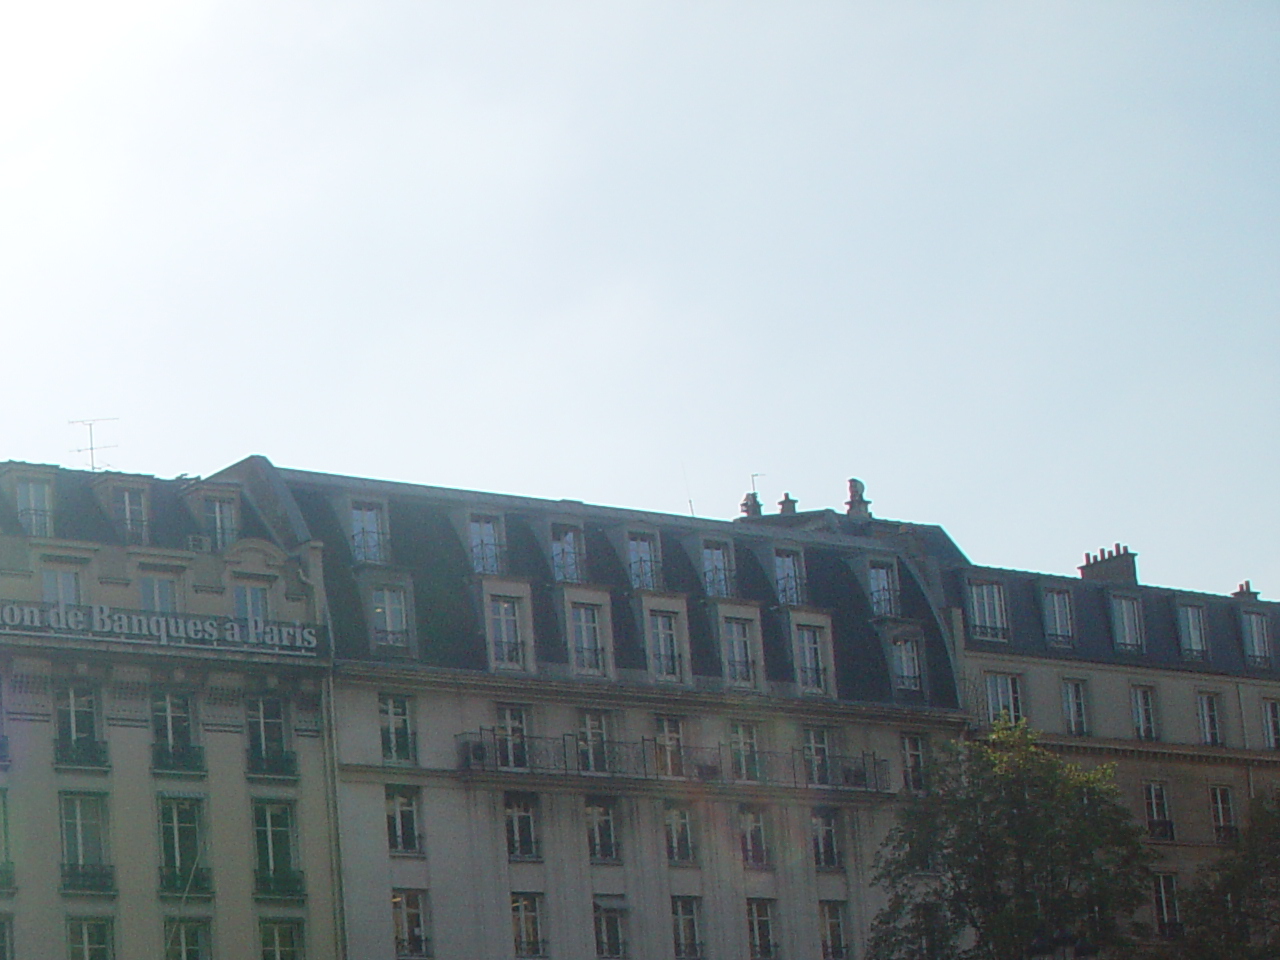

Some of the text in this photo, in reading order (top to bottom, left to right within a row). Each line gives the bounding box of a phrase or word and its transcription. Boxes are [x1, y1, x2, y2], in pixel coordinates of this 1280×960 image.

[49, 600, 83, 631] de
[91, 604, 218, 645] Banques
[225, 614, 241, 643] à
[248, 616, 318, 649] Paris
